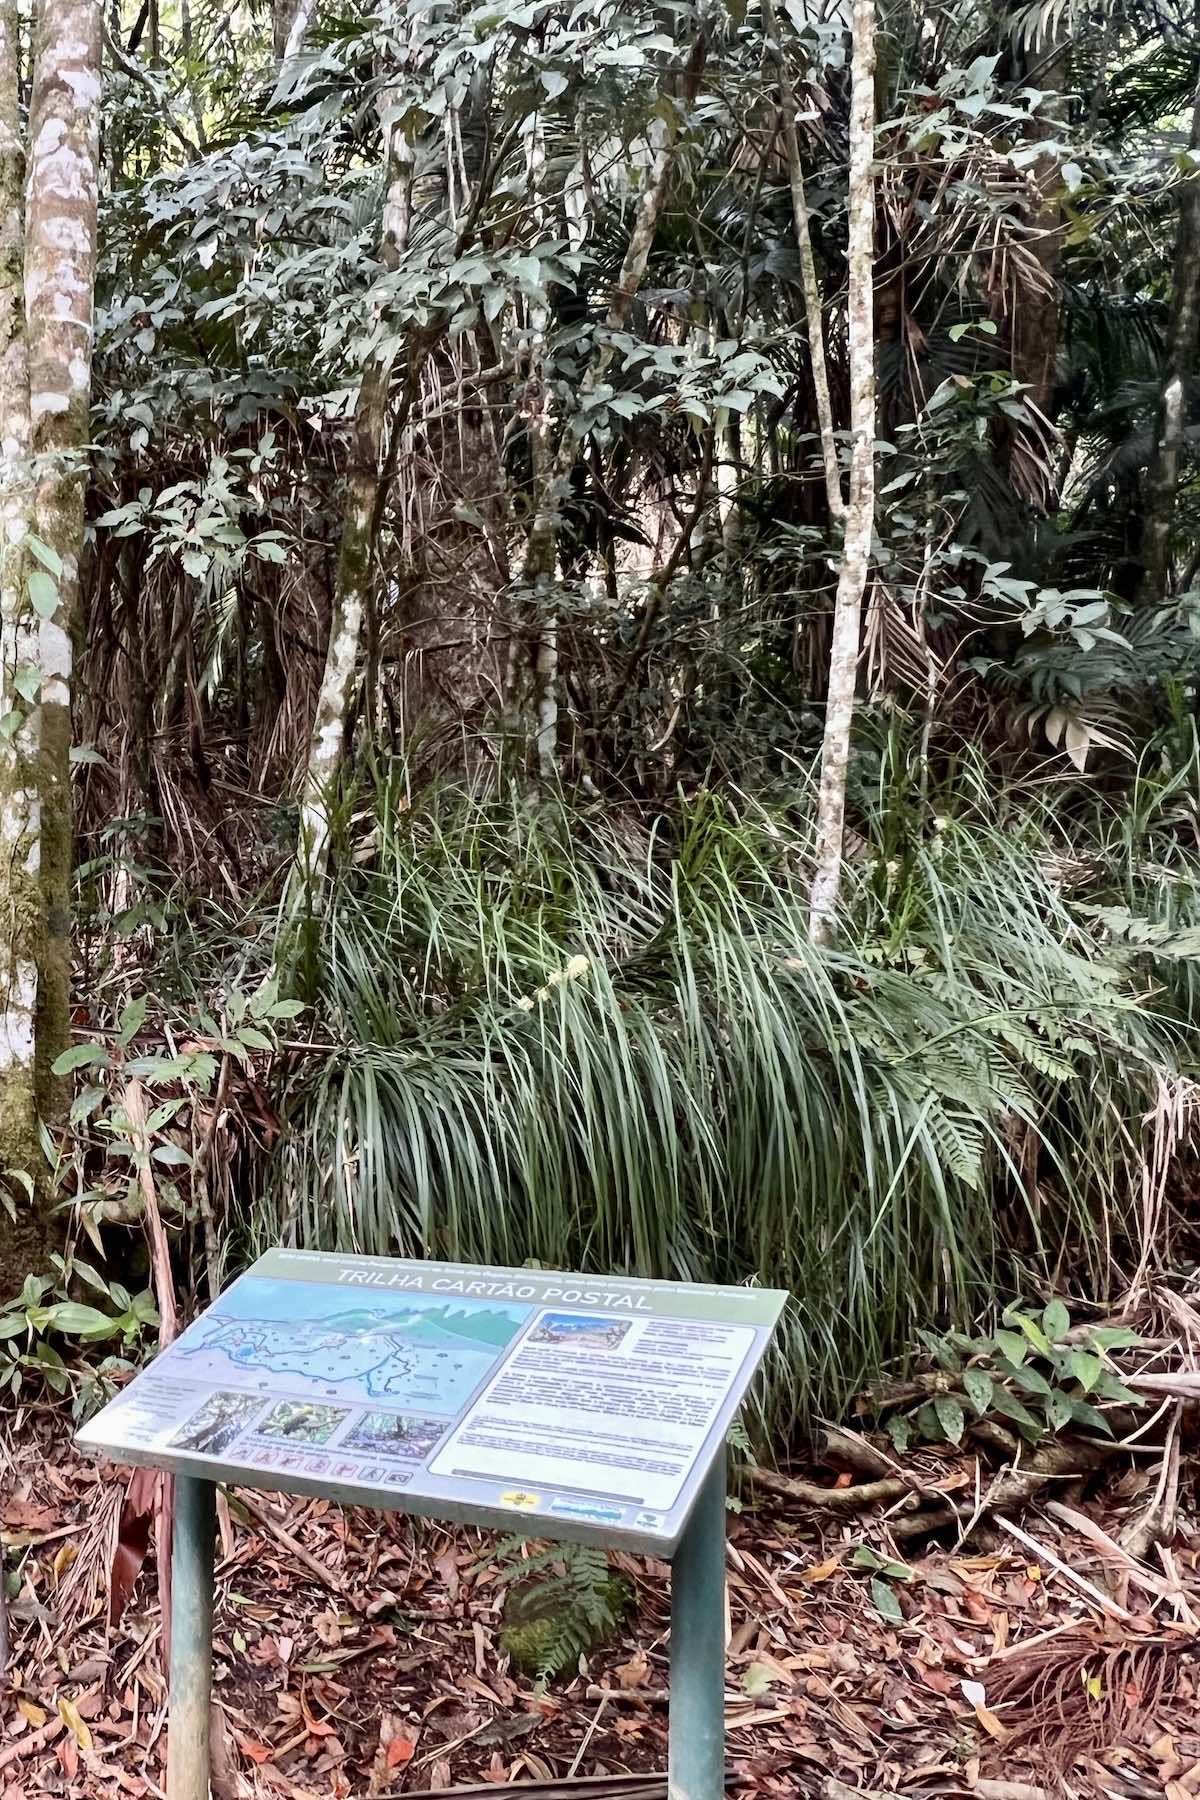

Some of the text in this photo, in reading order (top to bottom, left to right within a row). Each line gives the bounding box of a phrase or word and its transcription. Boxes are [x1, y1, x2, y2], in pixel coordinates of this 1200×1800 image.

[338, 1269, 423, 1288] TRILHA
[432, 1279, 536, 1298] CARTÃO
[541, 1288, 653, 1310] POSTAL
